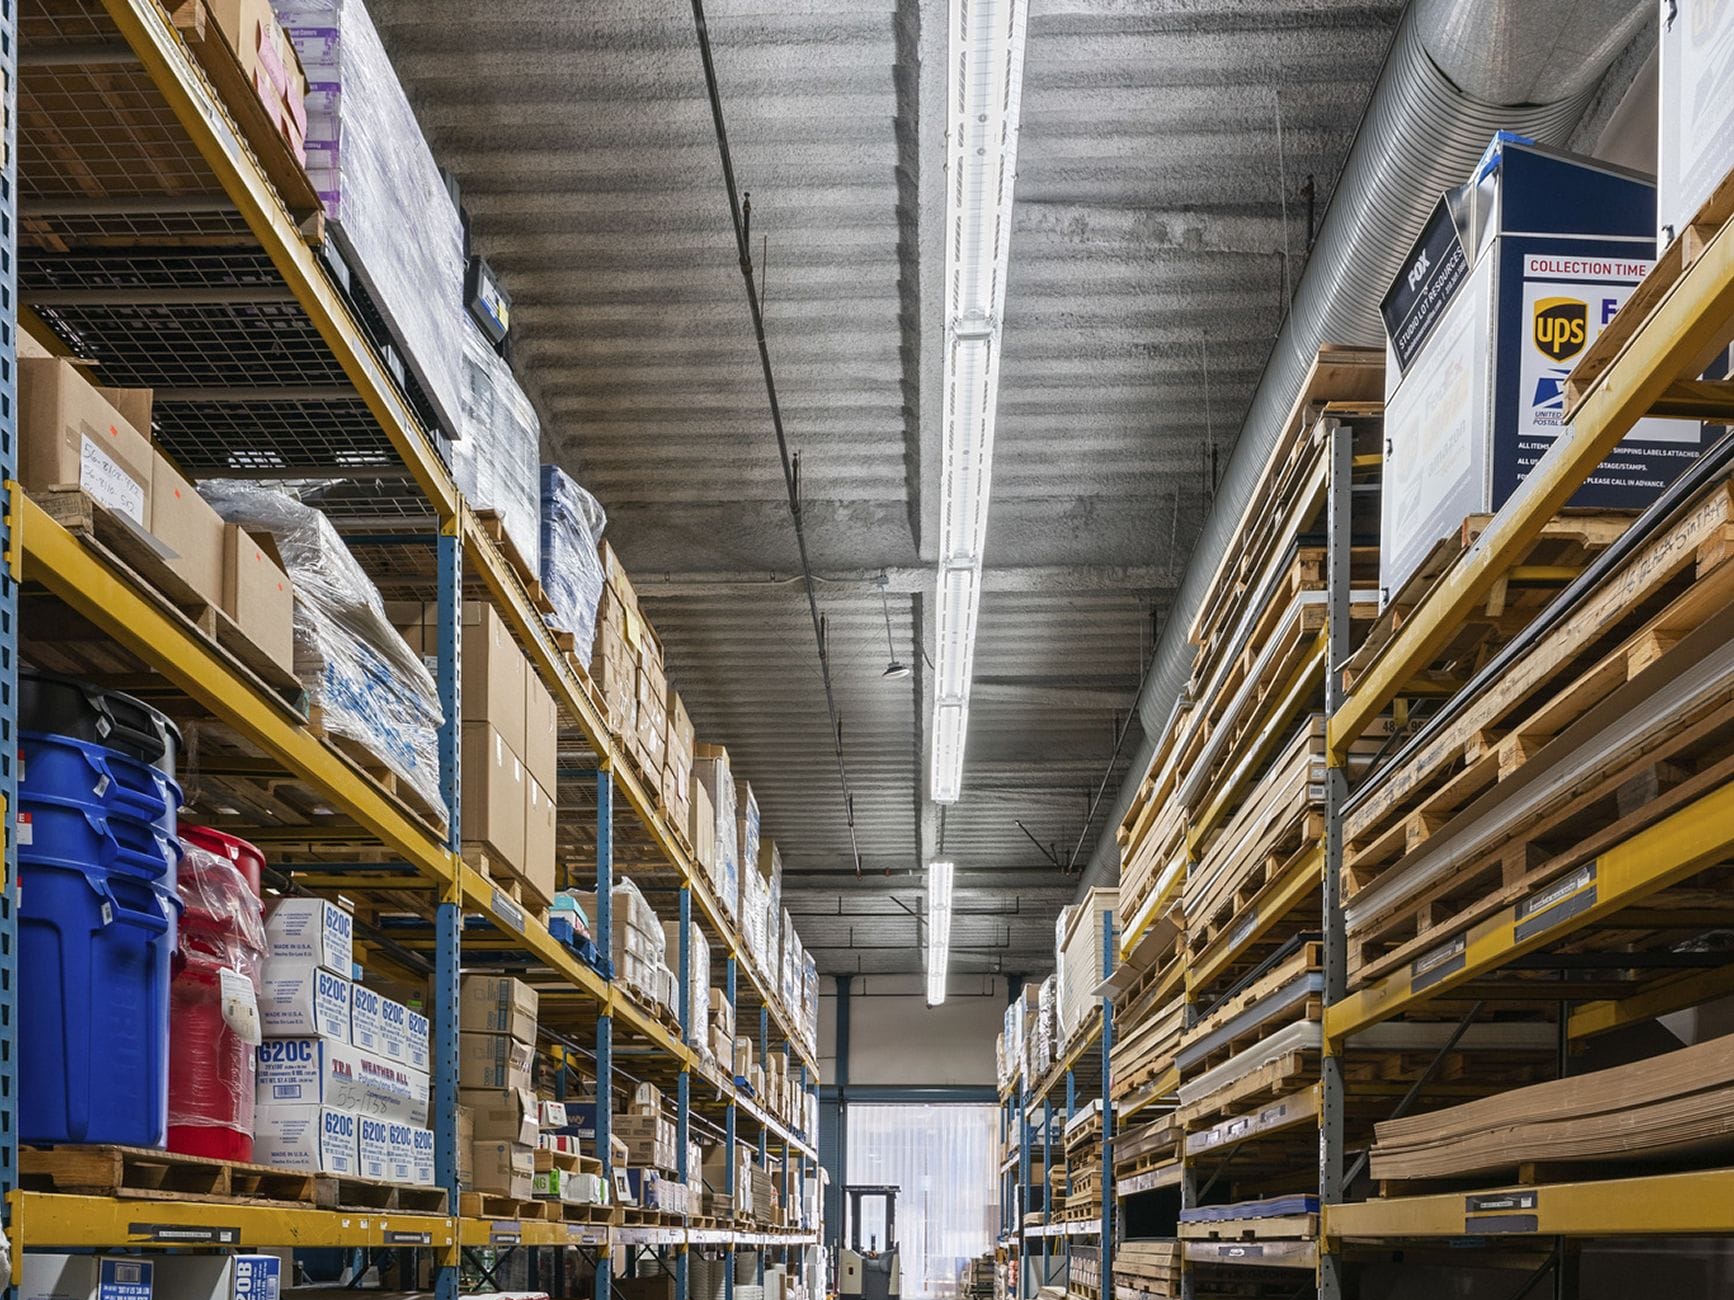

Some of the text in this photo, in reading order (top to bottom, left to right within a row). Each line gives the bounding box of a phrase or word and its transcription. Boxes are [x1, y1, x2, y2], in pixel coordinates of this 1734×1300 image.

[1408, 248, 1431, 292] FOX
[1530, 260, 1647, 276] COLLECTION TIME
[1398, 317, 1420, 351] STUDIO
[1417, 296, 1430, 319] LOT
[1428, 245, 1463, 305] RESOURCES
[1537, 318, 1584, 353] ups
[1535, 410, 1563, 419] UNITED
[1613, 447, 1643, 456] SHIPPING
[1643, 449, 1667, 457] LABELS
[1597, 462, 1649, 471] STAGE/STAMPS.
[1587, 477, 1611, 485] PLEASE
[1611, 478, 1627, 486] CALL
[1635, 480, 1666, 488] ADVANCE.
[1383, 720, 1396, 732] 48
[326, 906, 351, 939] 620C
[319, 974, 347, 1004] 620C
[355, 988, 378, 1016] 620C
[382, 1000, 404, 1025] 620C
[408, 1012, 428, 1037] 620C
[260, 1040, 312, 1062] 620C
[360, 1059, 408, 1086] WEATHER ALL
[325, 1112, 353, 1137] 620C
[363, 1120, 386, 1143] 620C
[389, 1125, 412, 1146] 620C
[414, 1131, 433, 1150] 620C
